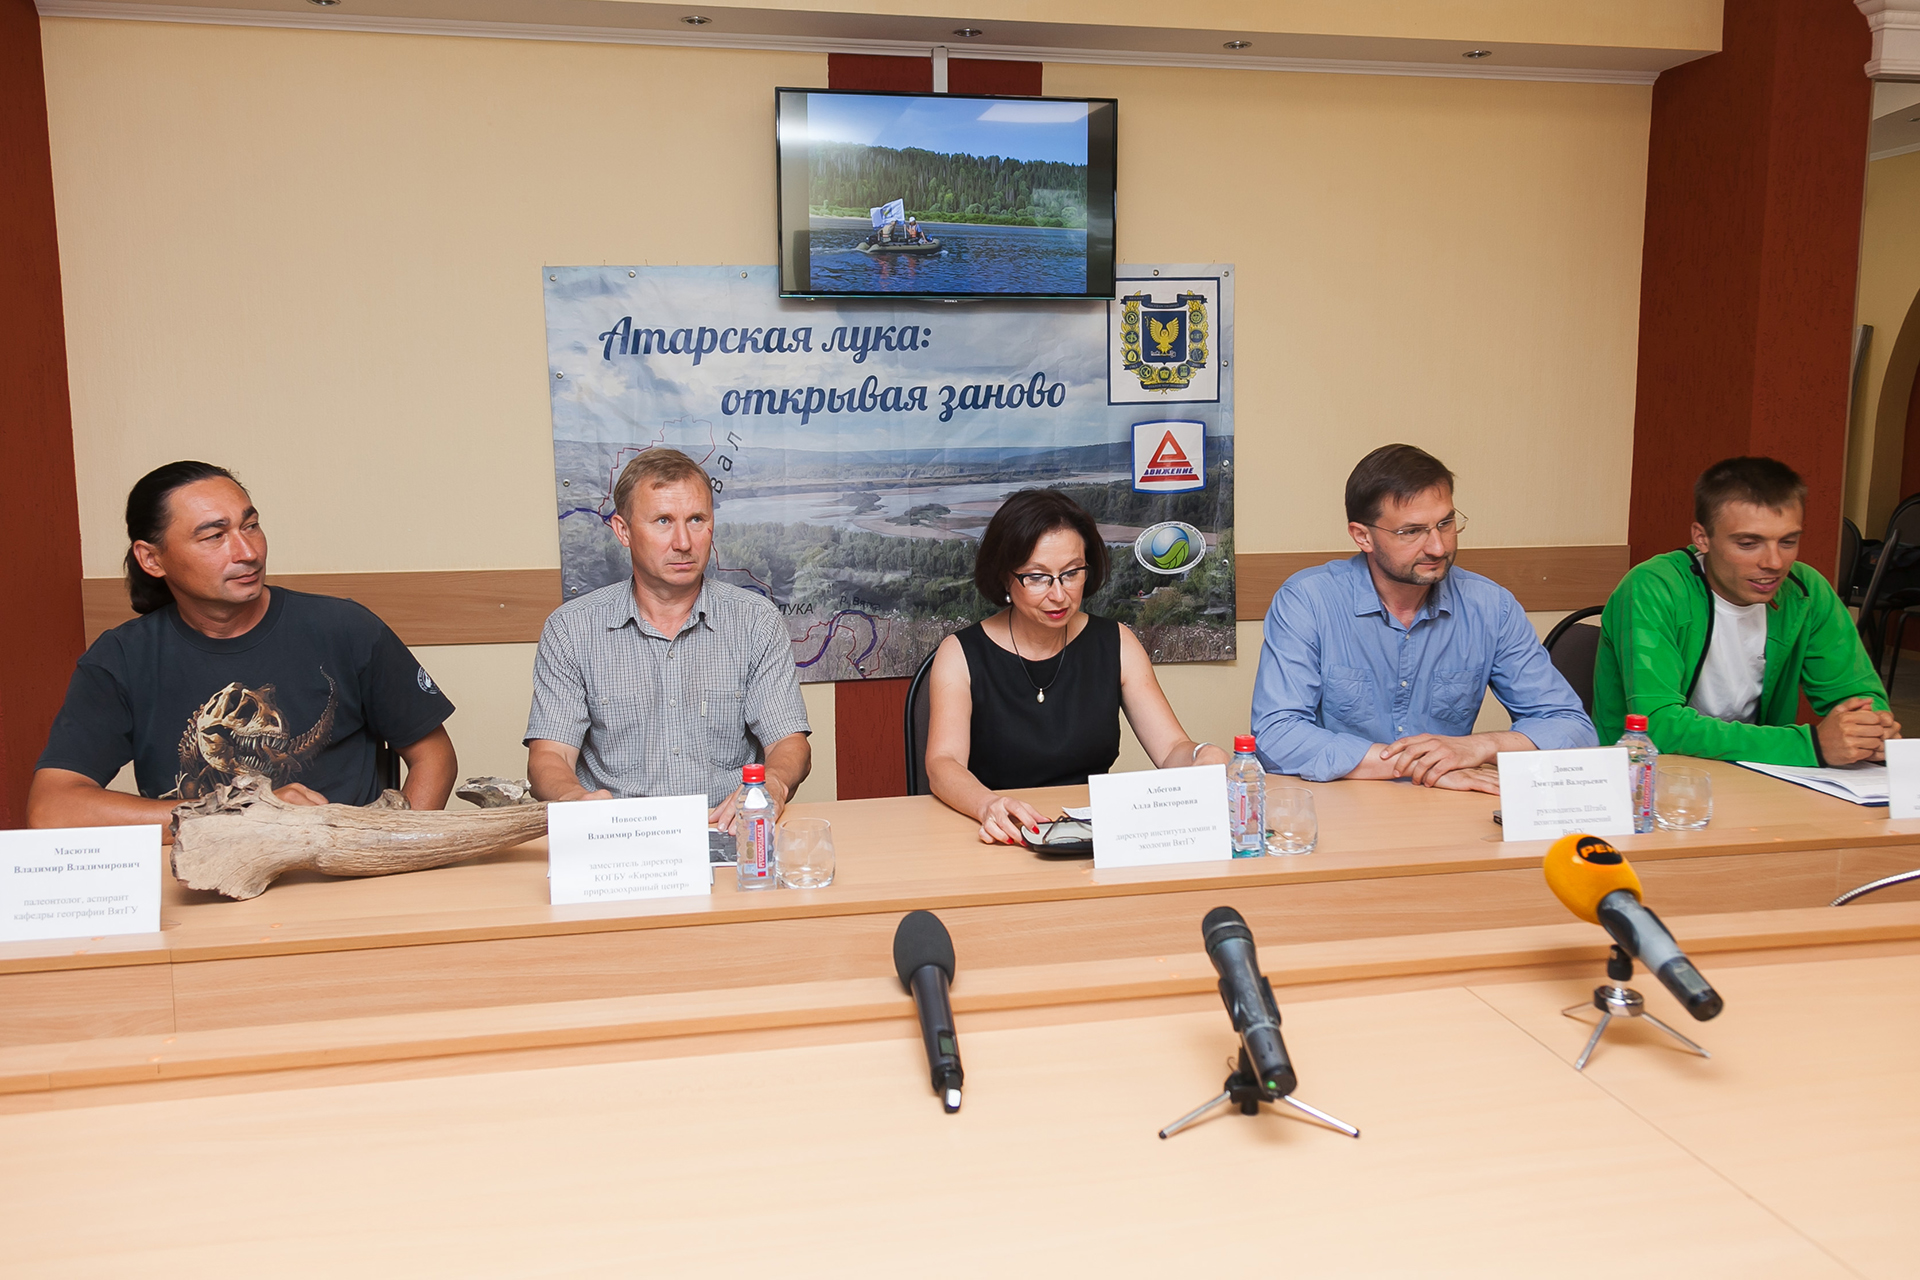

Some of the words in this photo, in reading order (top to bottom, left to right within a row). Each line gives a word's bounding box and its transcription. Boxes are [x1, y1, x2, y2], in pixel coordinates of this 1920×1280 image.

[598, 316, 812, 366] Атарская
[821, 325, 932, 364] лука:
[721, 375, 928, 426] открывая
[938, 371, 1066, 423] заново
[1143, 467, 1194, 476] ДВИЖЕНИЕ
[1153, 798, 1198, 809] Викторовна
[611, 815, 658, 824] Новоселов
[587, 832, 633, 841] Владимир
[634, 828, 682, 839] Борисович
[54, 847, 101, 856] Масютин
[13, 864, 64, 874] Владимир
[66, 861, 140, 872] Владимирович
[589, 861, 639, 870] заместитель
[641, 858, 683, 868] директора
[86, 894, 129, 904] аспирант
[13, 911, 54, 922] кафедры
[107, 905, 138, 916] ВятГУ
